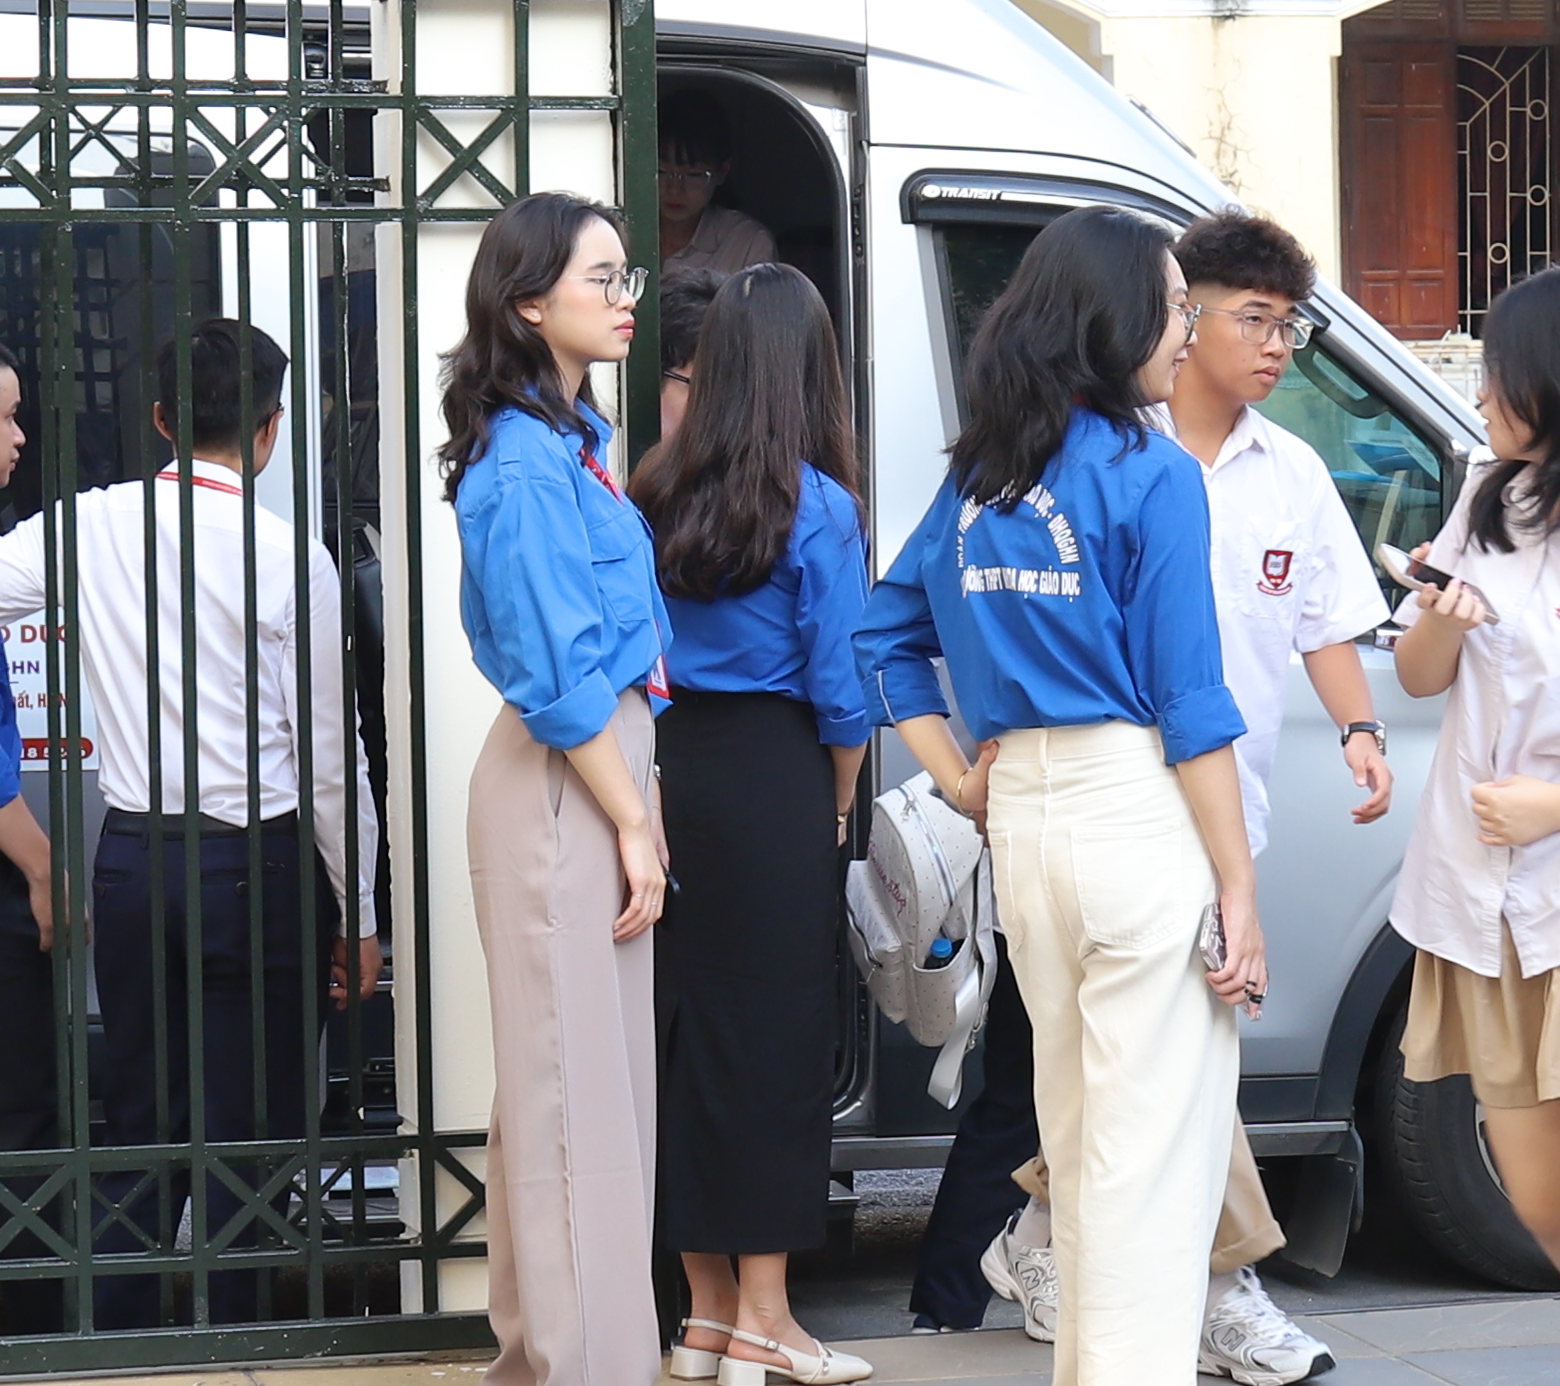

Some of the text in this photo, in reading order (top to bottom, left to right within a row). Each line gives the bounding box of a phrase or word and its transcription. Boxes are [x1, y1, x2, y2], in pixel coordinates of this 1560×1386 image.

[1018, 569, 1038, 600] HỌC
[1061, 571, 1081, 602] DỤC
[1220, 1326, 1247, 1352] N
